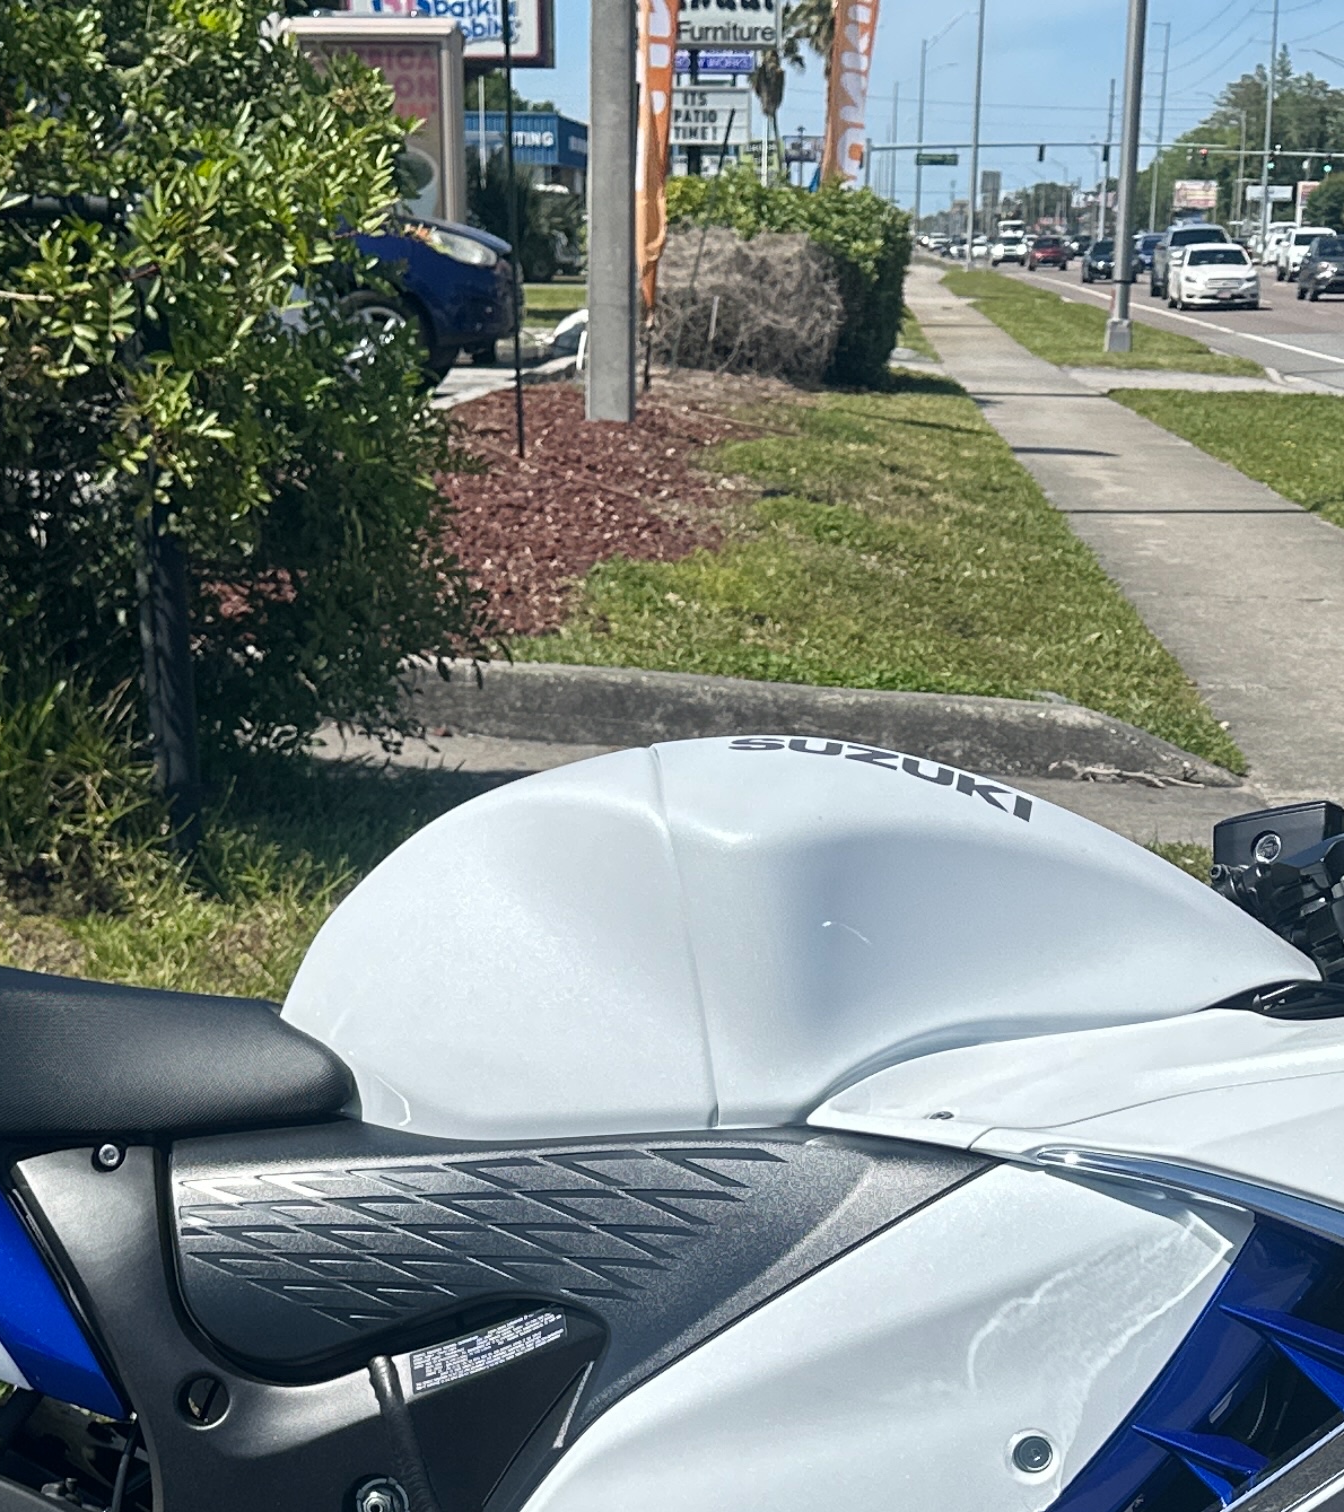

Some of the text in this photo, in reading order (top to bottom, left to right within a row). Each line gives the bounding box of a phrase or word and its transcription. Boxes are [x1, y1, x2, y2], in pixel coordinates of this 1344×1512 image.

[678, 21, 776, 41] Furniture
[683, 90, 708, 106] ITS
[674, 110, 717, 123] PATIO
[728, 737, 1033, 823] SUZUKI
